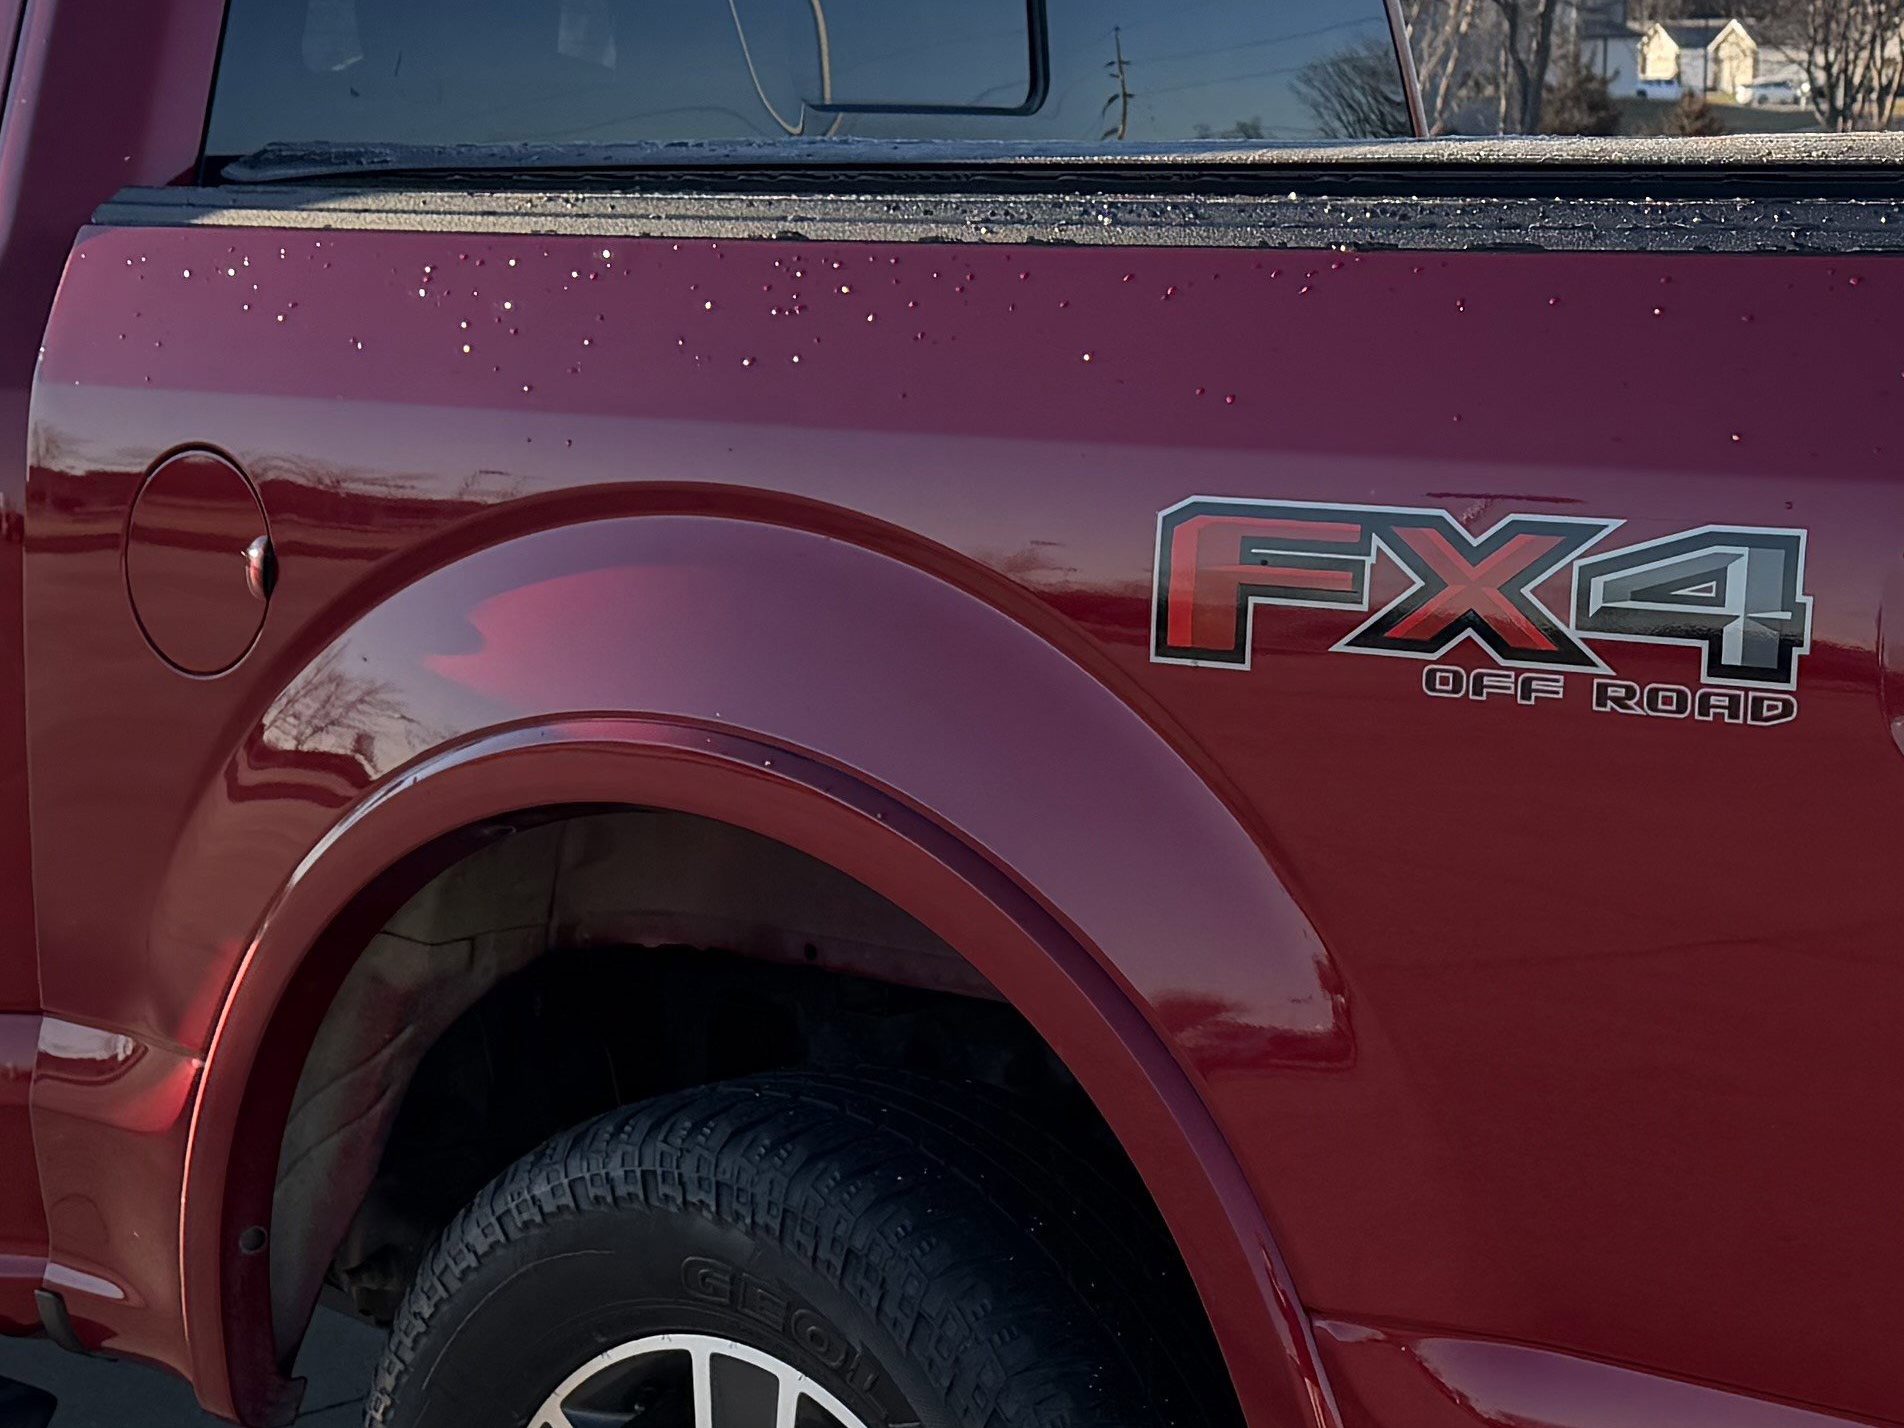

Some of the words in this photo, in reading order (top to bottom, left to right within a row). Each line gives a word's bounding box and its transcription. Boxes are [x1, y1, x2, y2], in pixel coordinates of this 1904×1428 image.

[1150, 494, 1813, 690] FX4
[1422, 665, 1564, 706] OFF
[1592, 676, 1797, 727] ROAD
